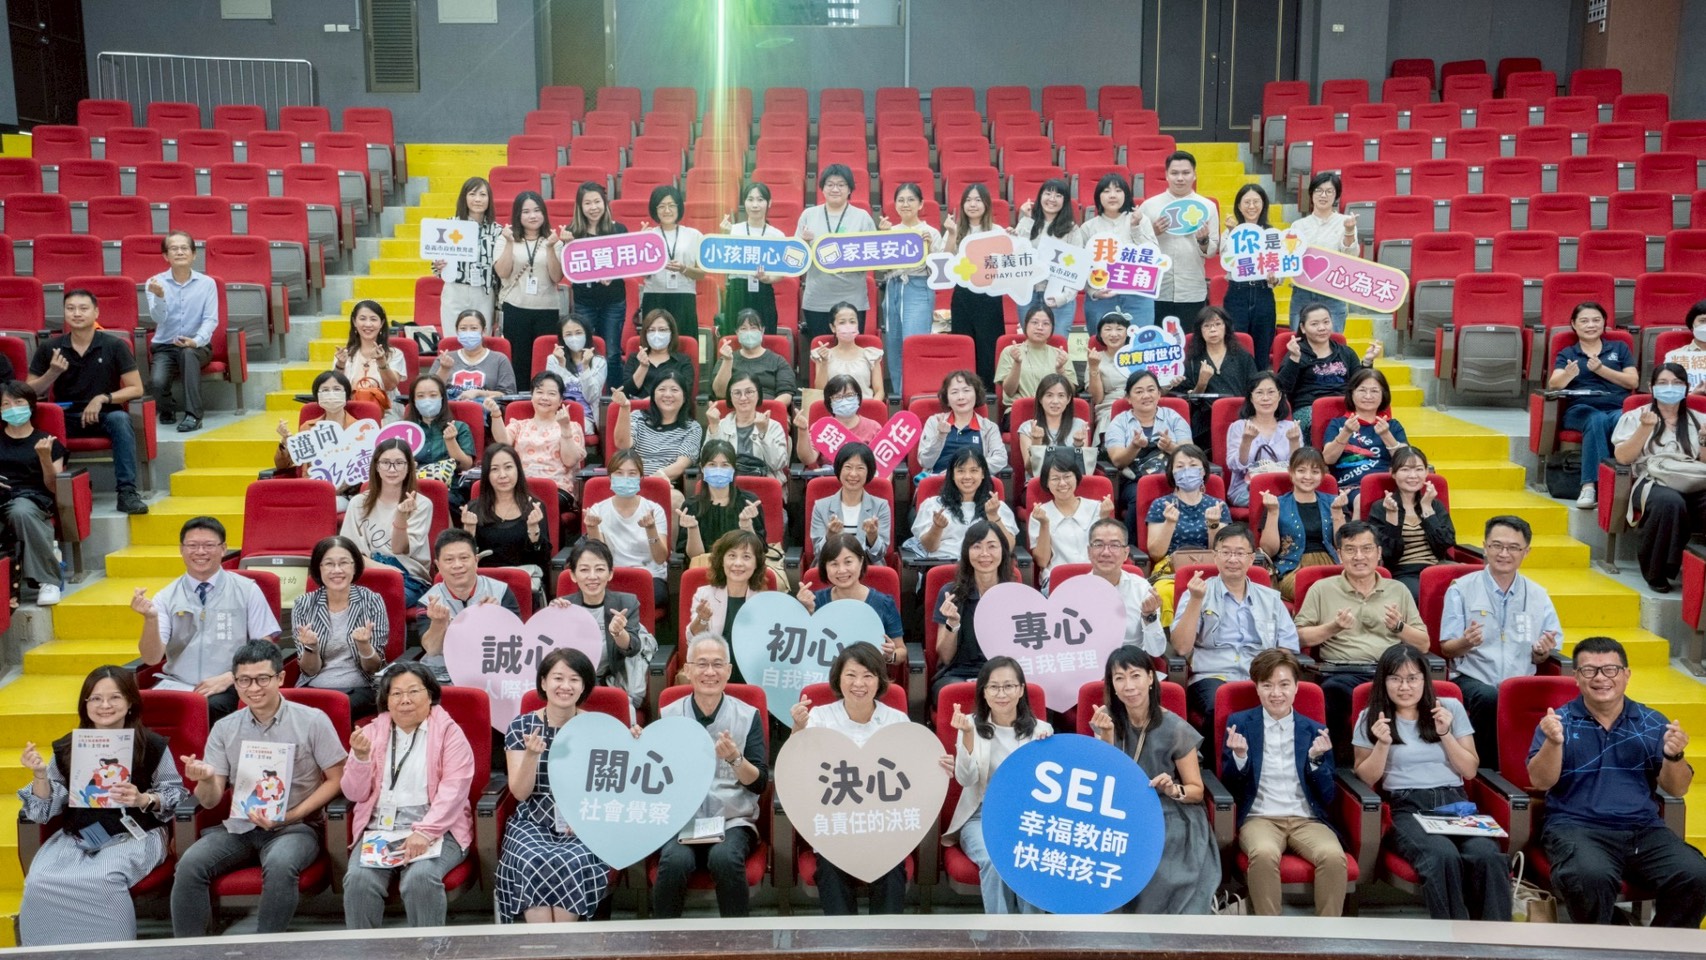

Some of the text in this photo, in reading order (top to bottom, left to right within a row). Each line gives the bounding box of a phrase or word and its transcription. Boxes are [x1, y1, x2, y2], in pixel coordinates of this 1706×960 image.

[704, 244, 781, 266] 小孩開心
[842, 238, 919, 262] 家長安心
[1093, 238, 1154, 264] 我就是
[1231, 229, 1281, 254] 你是
[568, 240, 662, 274] 品質用心
[983, 252, 1034, 269] 嘉義市
[1236, 252, 1300, 277] 最棒的
[984, 270, 1034, 280] CHIAYI CITY
[1110, 266, 1151, 288] 主角
[1326, 265, 1399, 302] 心為本
[1118, 345, 1182, 366] 教育新世代
[290, 423, 339, 462] 邁向
[874, 418, 917, 468] 同在
[1011, 607, 1093, 650] 專心
[481, 634, 554, 675] 誠心
[766, 622, 844, 668] 初心
[1021, 649, 1098, 676] 自我管理
[762, 667, 830, 690] 自我認
[585, 748, 674, 795] 關心
[818, 757, 911, 806] 決心
[1031, 760, 1126, 820] SEL
[579, 799, 671, 825] 社會覺察
[813, 807, 922, 836] 負責任的決策
[1018, 810, 1129, 857] 幸福教師
[1013, 840, 1123, 889] 快樂孩子
